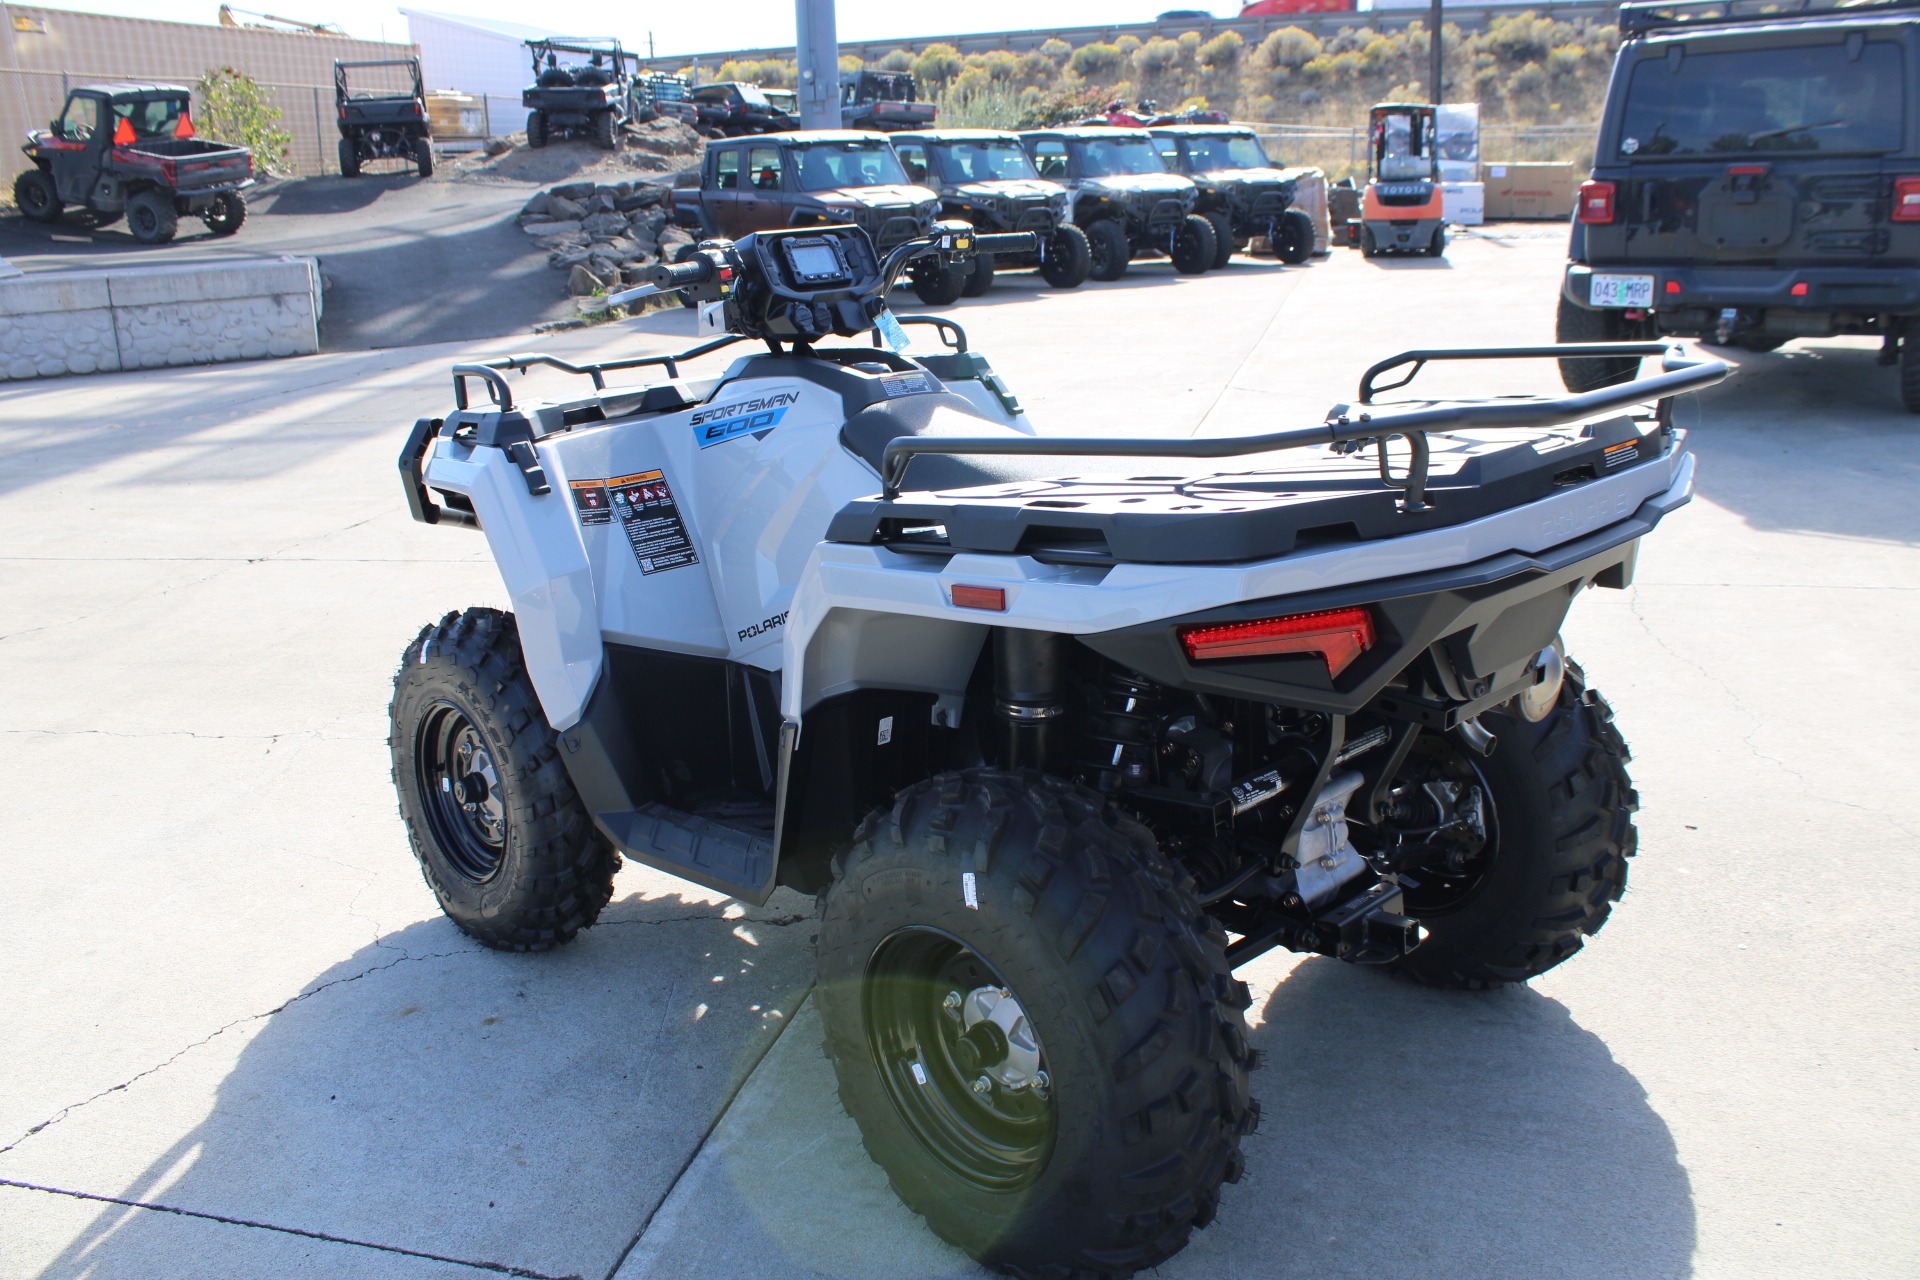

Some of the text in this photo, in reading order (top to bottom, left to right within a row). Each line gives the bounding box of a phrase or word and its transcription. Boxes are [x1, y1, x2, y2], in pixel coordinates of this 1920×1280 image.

[1383, 185, 1427, 195] TOYOTA
[1594, 281, 1651, 299] 043 MRP
[689, 391, 800, 426] SPORTSMAN
[705, 412, 775, 439] 600
[625, 474, 648, 484] WARNING
